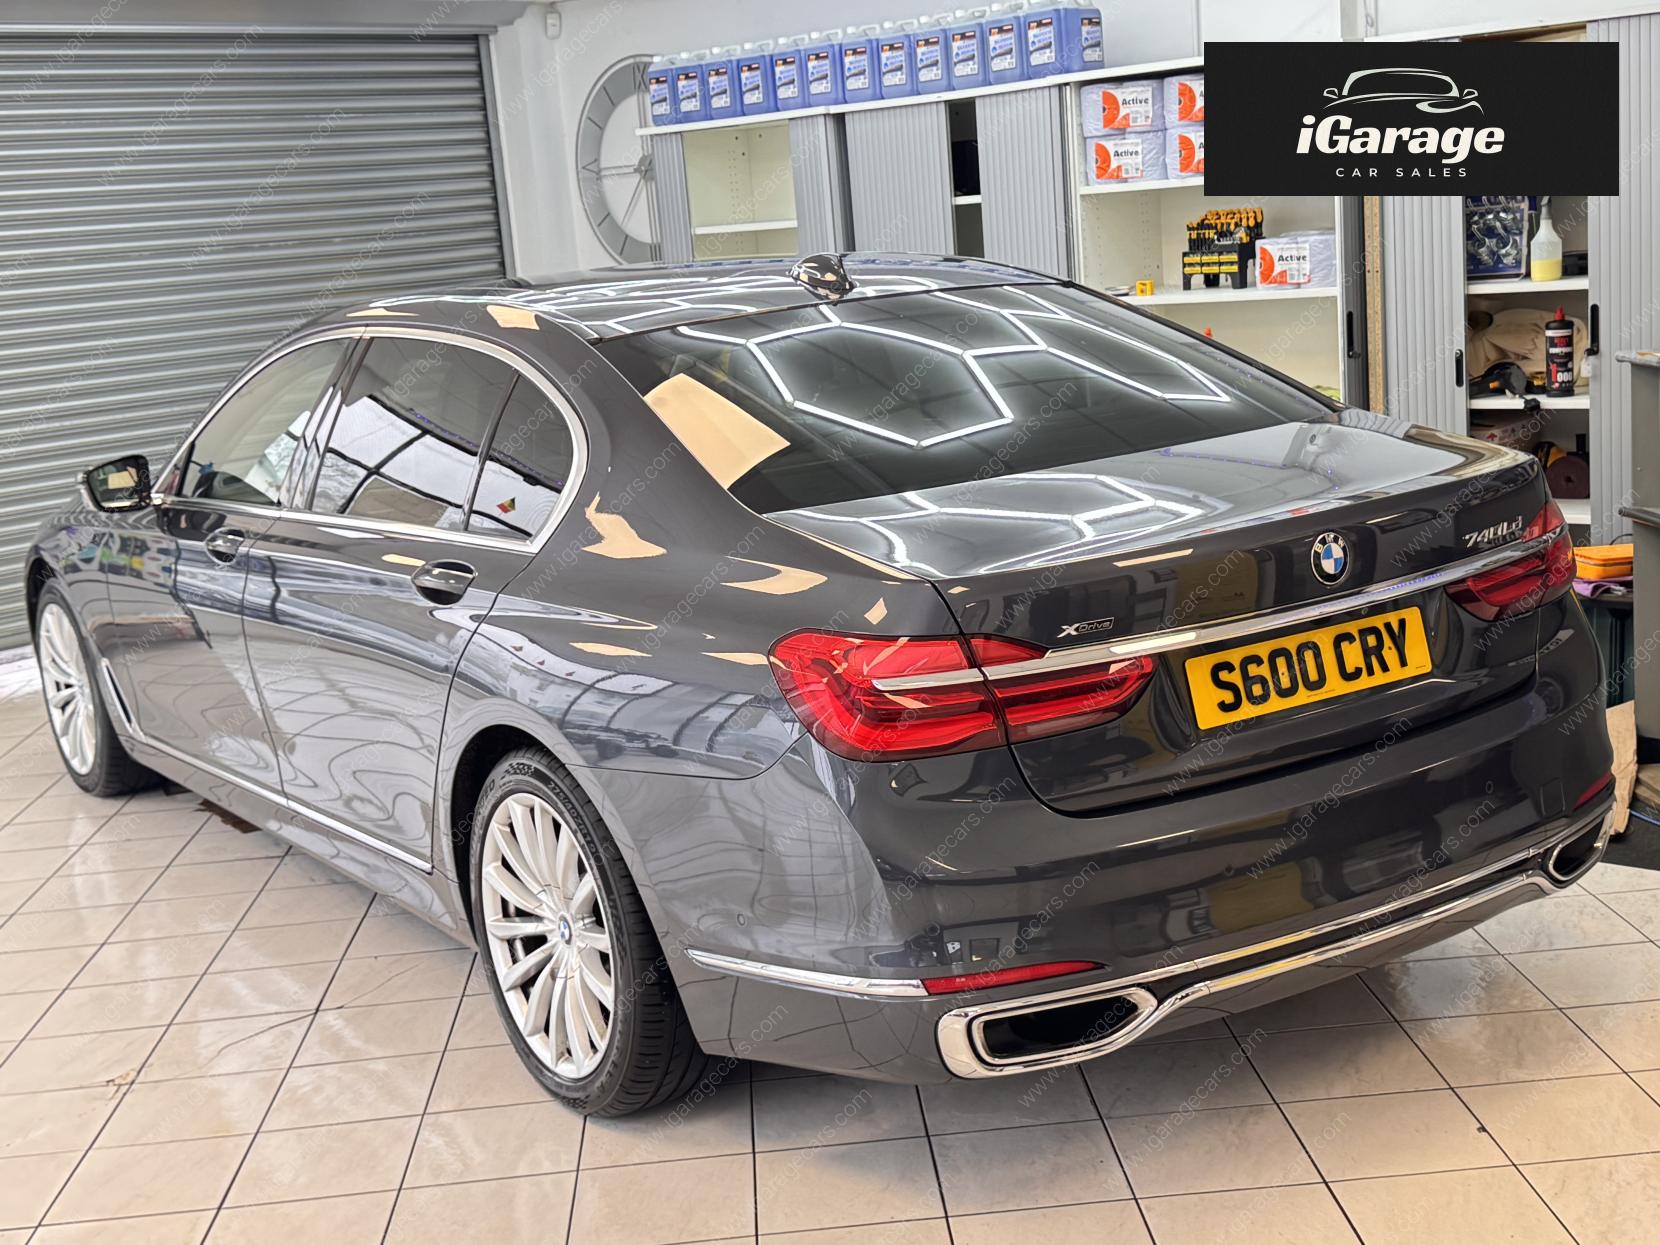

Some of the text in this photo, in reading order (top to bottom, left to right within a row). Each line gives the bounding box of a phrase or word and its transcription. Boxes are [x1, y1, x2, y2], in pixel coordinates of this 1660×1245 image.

[1121, 96, 1149, 106] Active
[1113, 149, 1139, 157] Active
[1277, 252, 1307, 263] Active
[1314, 532, 1346, 553] BMW
[1210, 618, 1407, 714] S600 CRY
